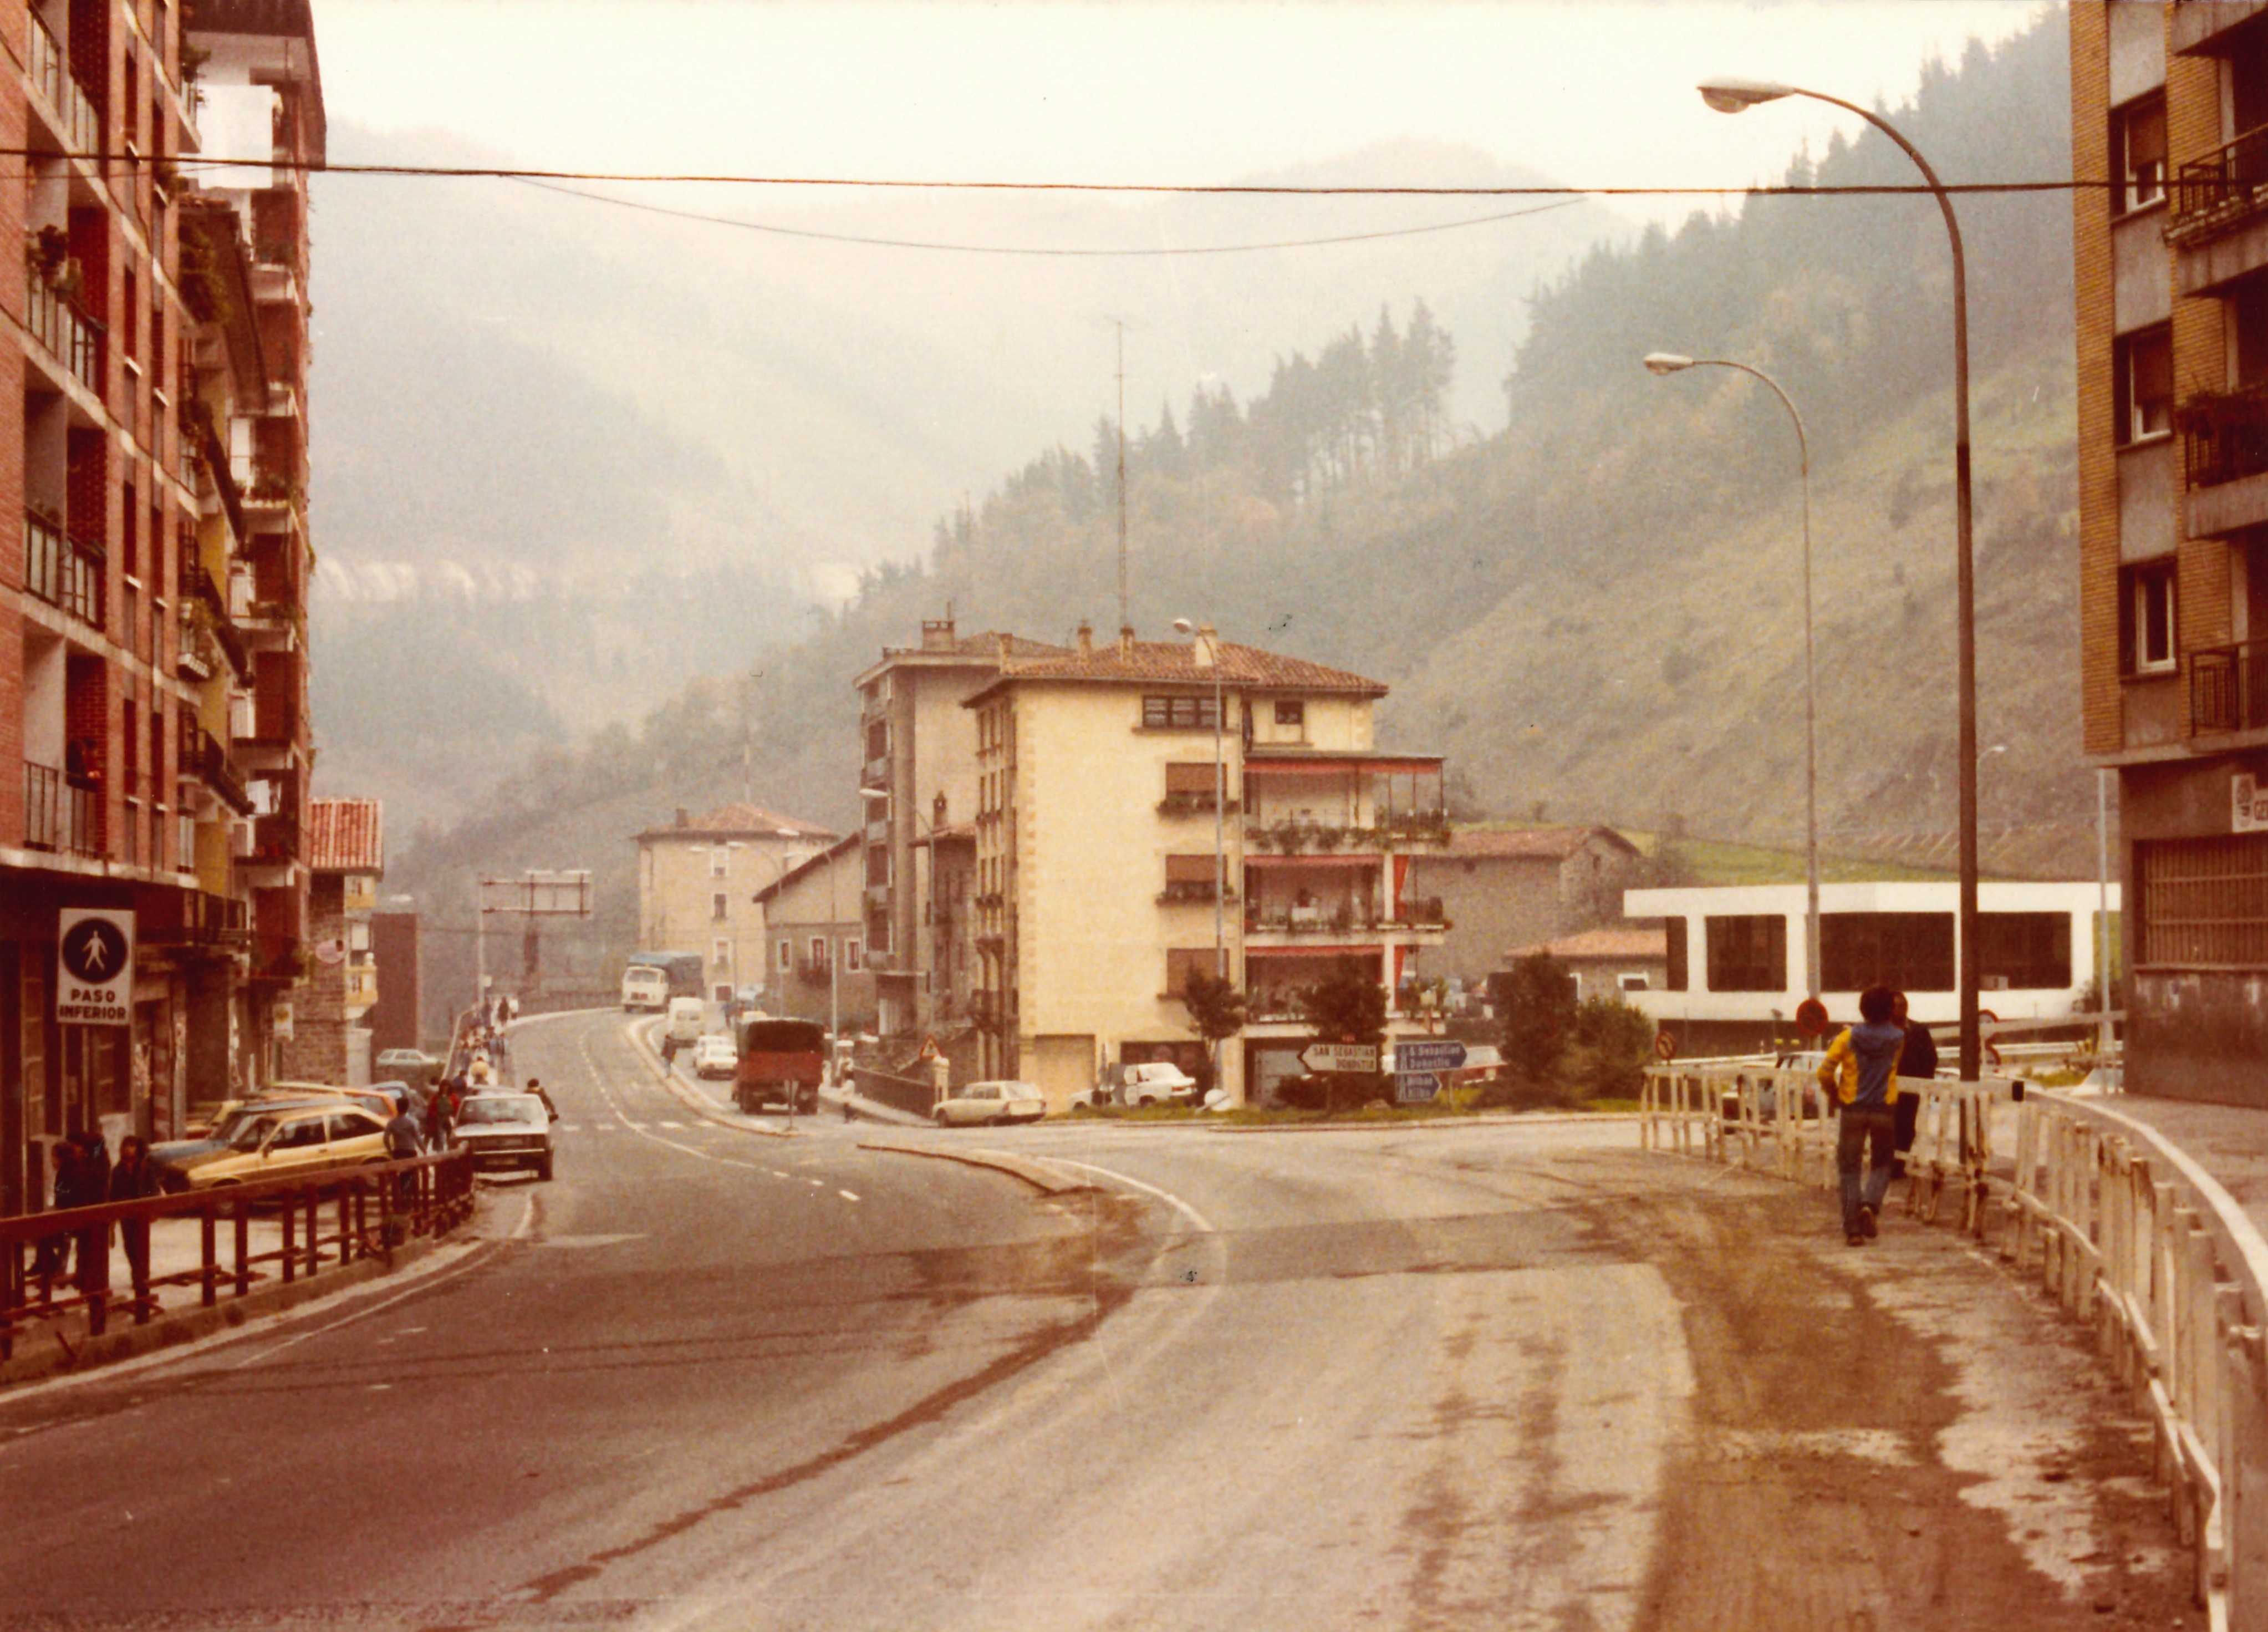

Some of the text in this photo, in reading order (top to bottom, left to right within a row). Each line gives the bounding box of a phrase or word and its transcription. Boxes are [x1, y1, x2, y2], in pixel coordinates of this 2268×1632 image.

[70, 988, 115, 1003] PASO
[59, 1004, 126, 1019] INFERIOR
[1313, 1045, 1329, 1056] SAN
